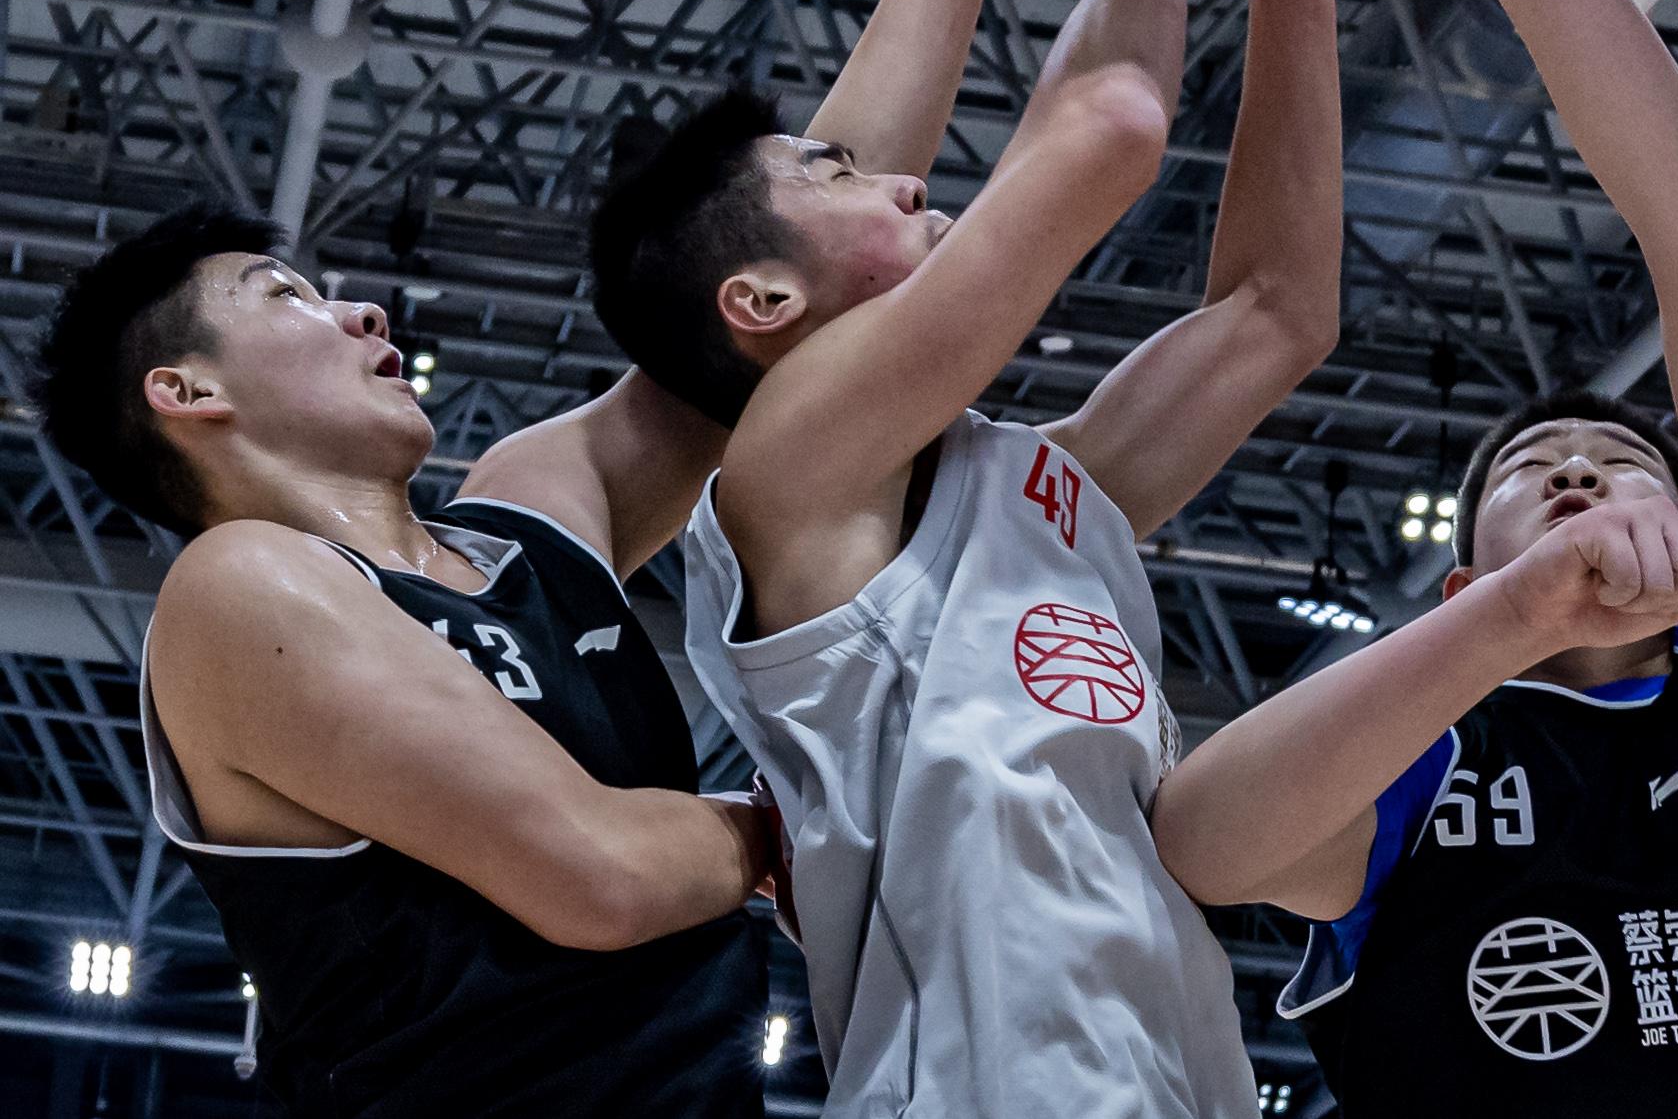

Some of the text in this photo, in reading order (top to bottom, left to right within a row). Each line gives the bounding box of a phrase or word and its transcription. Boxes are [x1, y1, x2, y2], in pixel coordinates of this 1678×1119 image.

[1023, 443, 1081, 550] 49
[1434, 765, 1535, 847] 59
[1641, 1026, 1668, 1047] JOE
